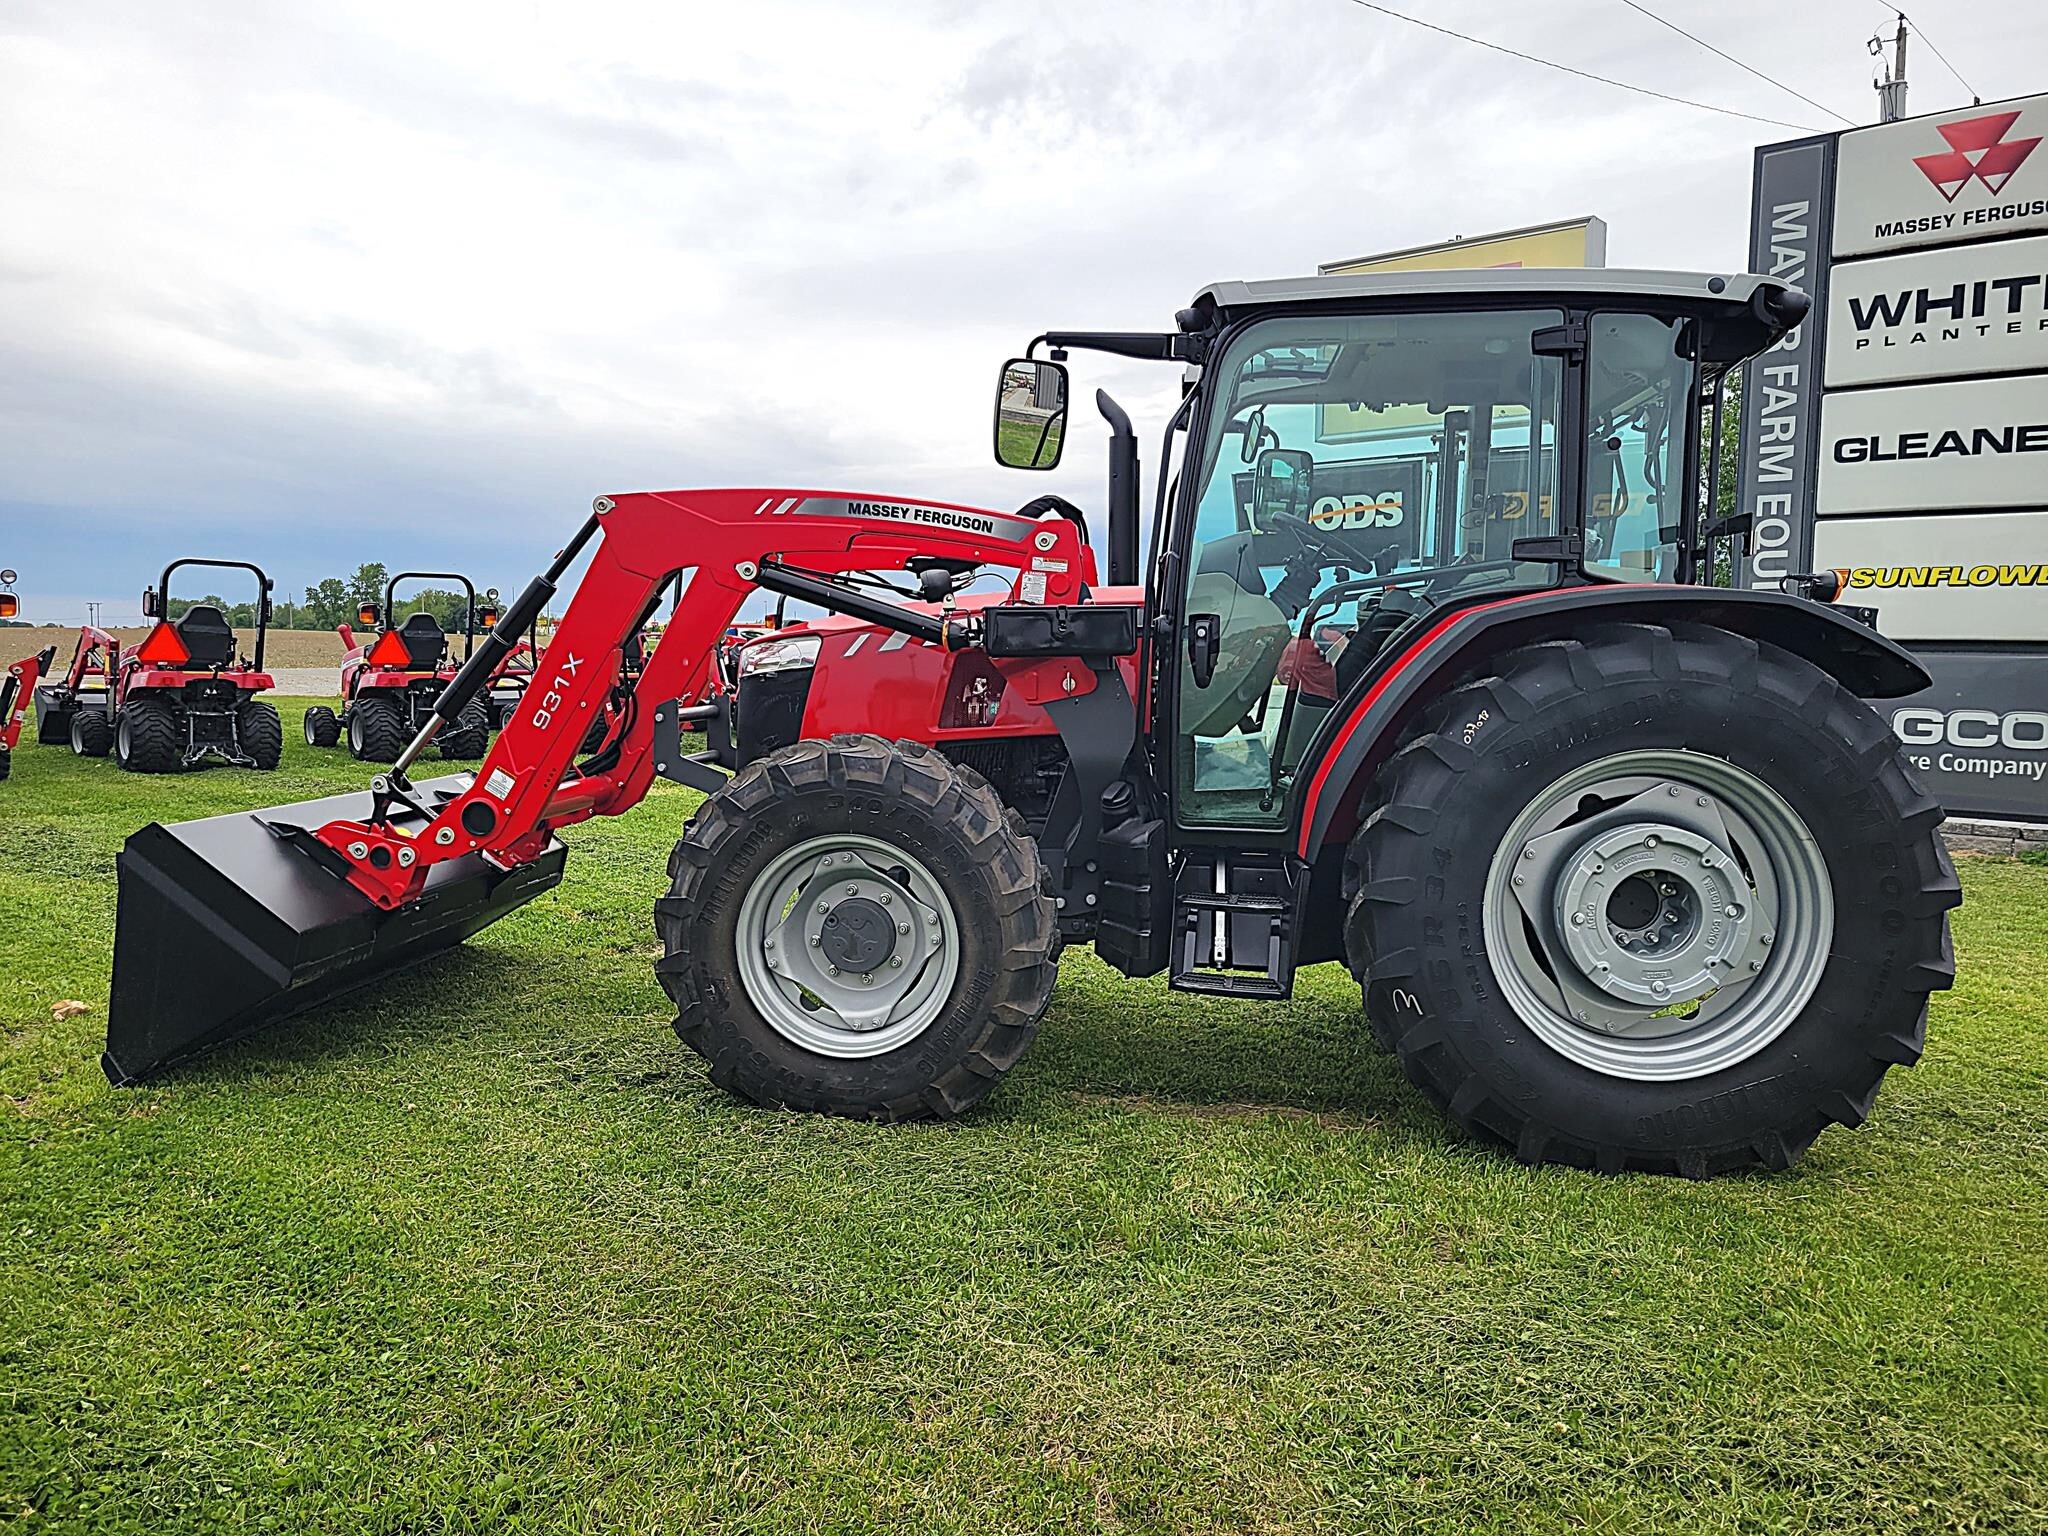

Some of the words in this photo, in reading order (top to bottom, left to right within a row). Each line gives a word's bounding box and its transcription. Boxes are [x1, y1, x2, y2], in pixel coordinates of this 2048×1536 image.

[1875, 213, 1956, 238] MASSEY
[1963, 200, 2048, 226] FERGUS
[1765, 200, 1809, 353] MAYR
[1848, 274, 2048, 332] WHIT
[1758, 364, 1799, 483] FARM
[848, 502, 910, 519] MASSEY
[914, 509, 994, 533] FERGUSON
[532, 675, 570, 730] 931
[1938, 753, 2047, 781] Company
